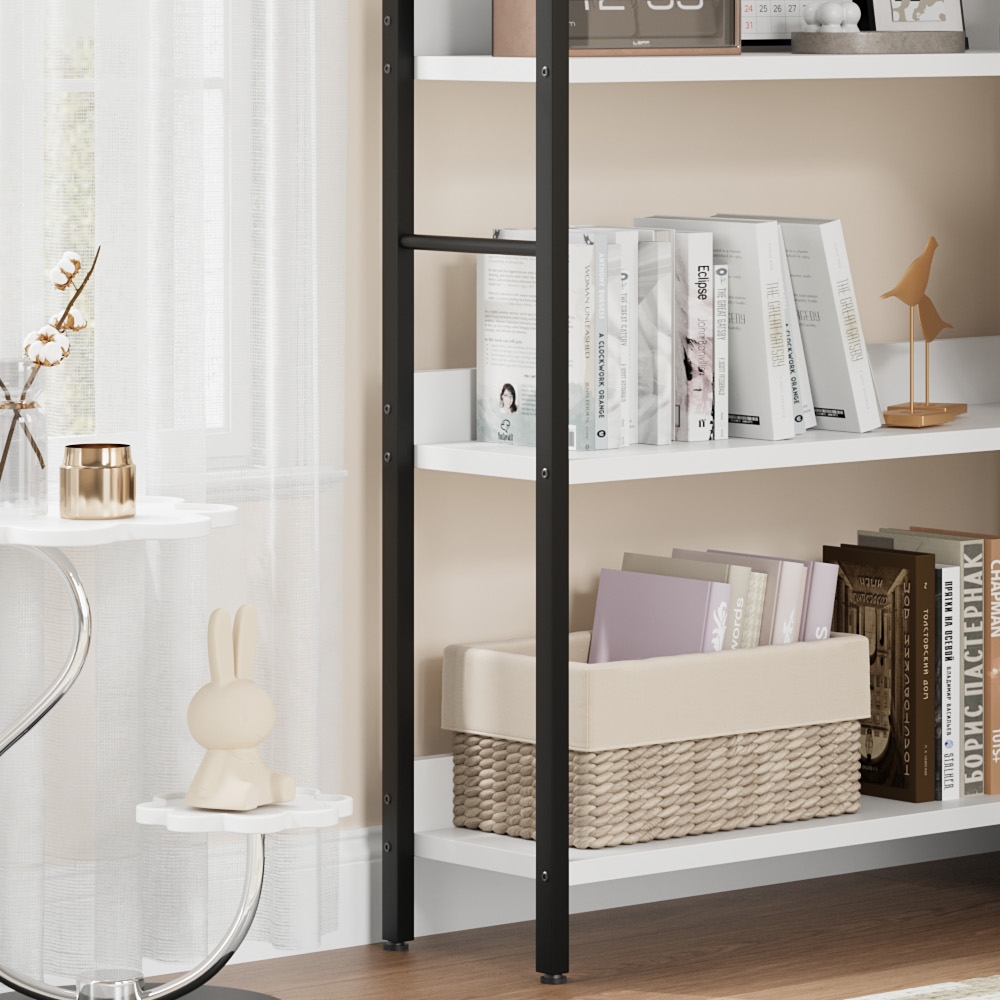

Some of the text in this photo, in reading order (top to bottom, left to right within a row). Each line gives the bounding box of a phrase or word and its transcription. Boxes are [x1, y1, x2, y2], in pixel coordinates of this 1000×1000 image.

[745, 4, 753, 13] 24
[759, 4, 768, 13] 25
[773, 4, 782, 13] 26
[788, 4, 796, 13] 27
[695, 265, 710, 300] Eclipse
[766, 282, 781, 297] THE
[836, 279, 851, 294] THE
[717, 288, 726, 298] THE
[717, 300, 726, 316] GREAT
[697, 318, 708, 337] John
[717, 319, 726, 341] GATSBY
[790, 376, 800, 404] ORANGE
[944, 580, 953, 613] ПРЯТКИ
[944, 616, 953, 627] НА
[944, 630, 955, 662] ОСЕВОЙ
[963, 551, 983, 783] БОРИС ПАСТЕРНАК
